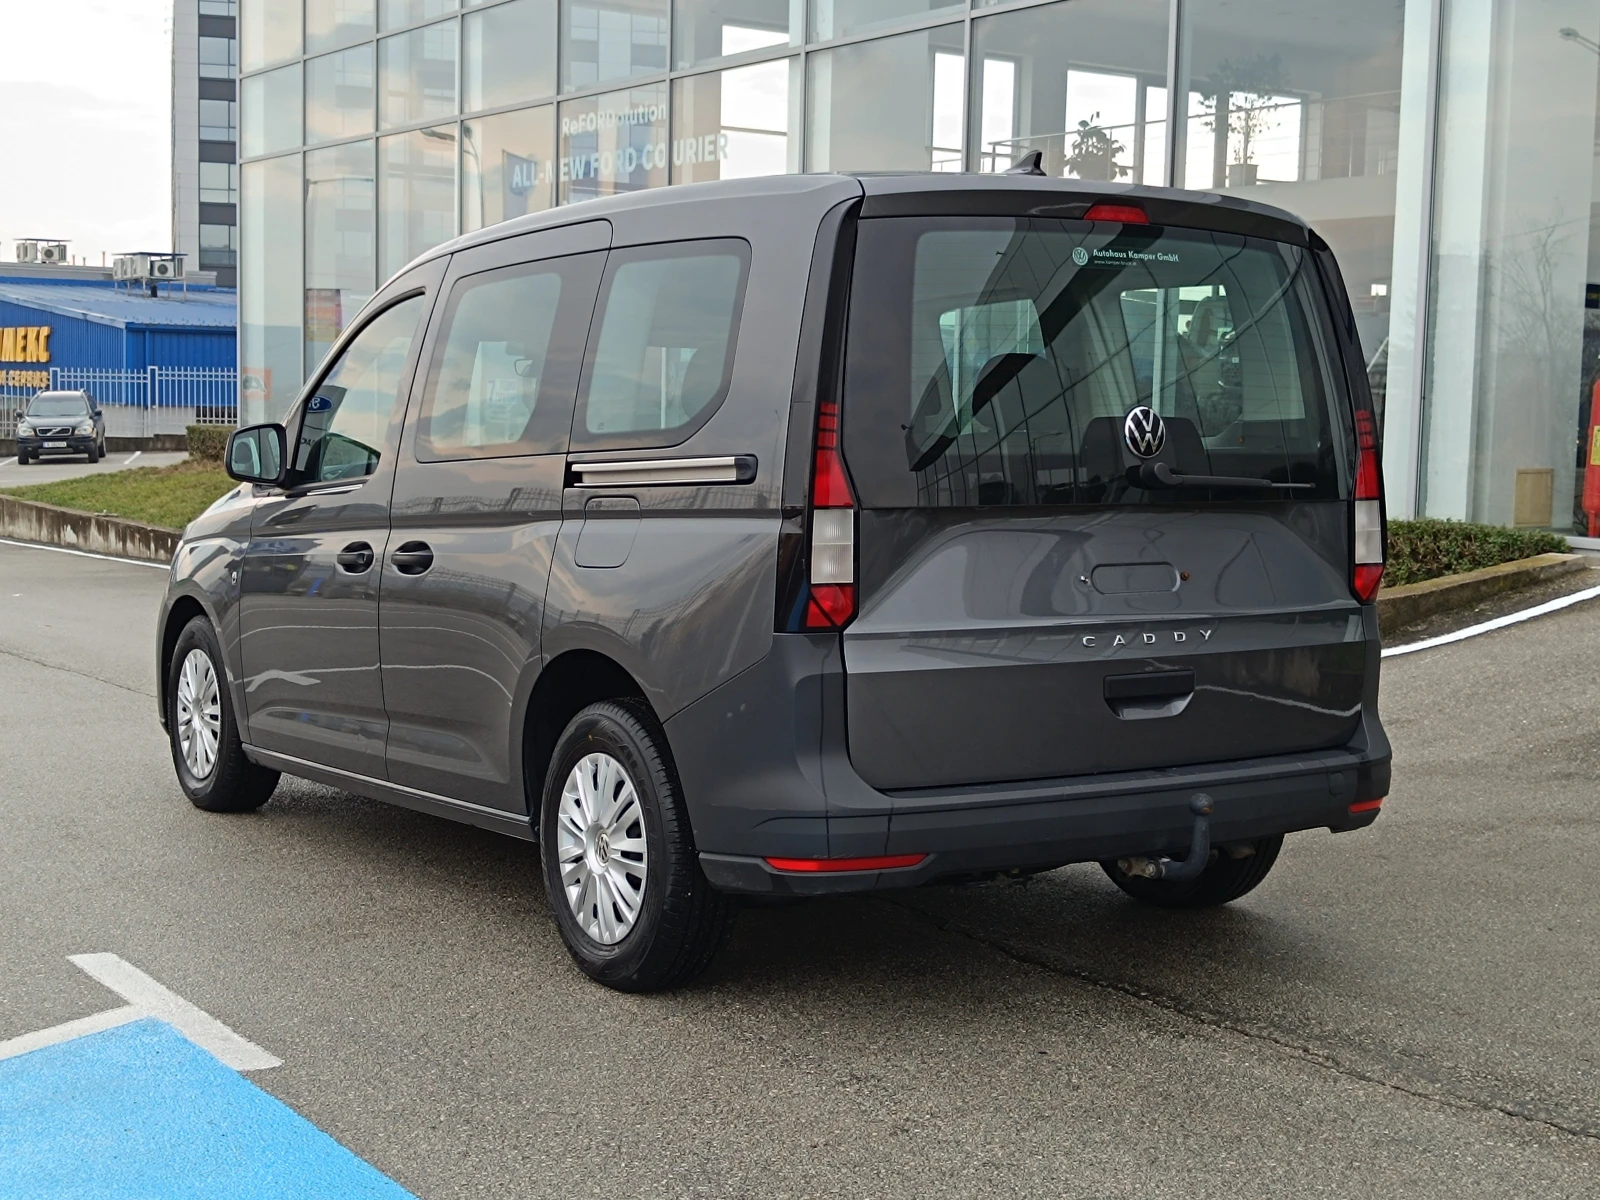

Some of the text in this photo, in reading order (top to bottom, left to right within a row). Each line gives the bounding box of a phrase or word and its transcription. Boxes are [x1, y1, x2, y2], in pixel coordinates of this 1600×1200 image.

[562, 103, 667, 137] ReFORDolution
[512, 133, 729, 189] ALL-NEW FORD COURIER
[1093, 248, 1179, 262] Autohaus Kamper GmbH
[0, 326, 51, 363] МЕКС
[1082, 629, 1212, 647] CADDY
